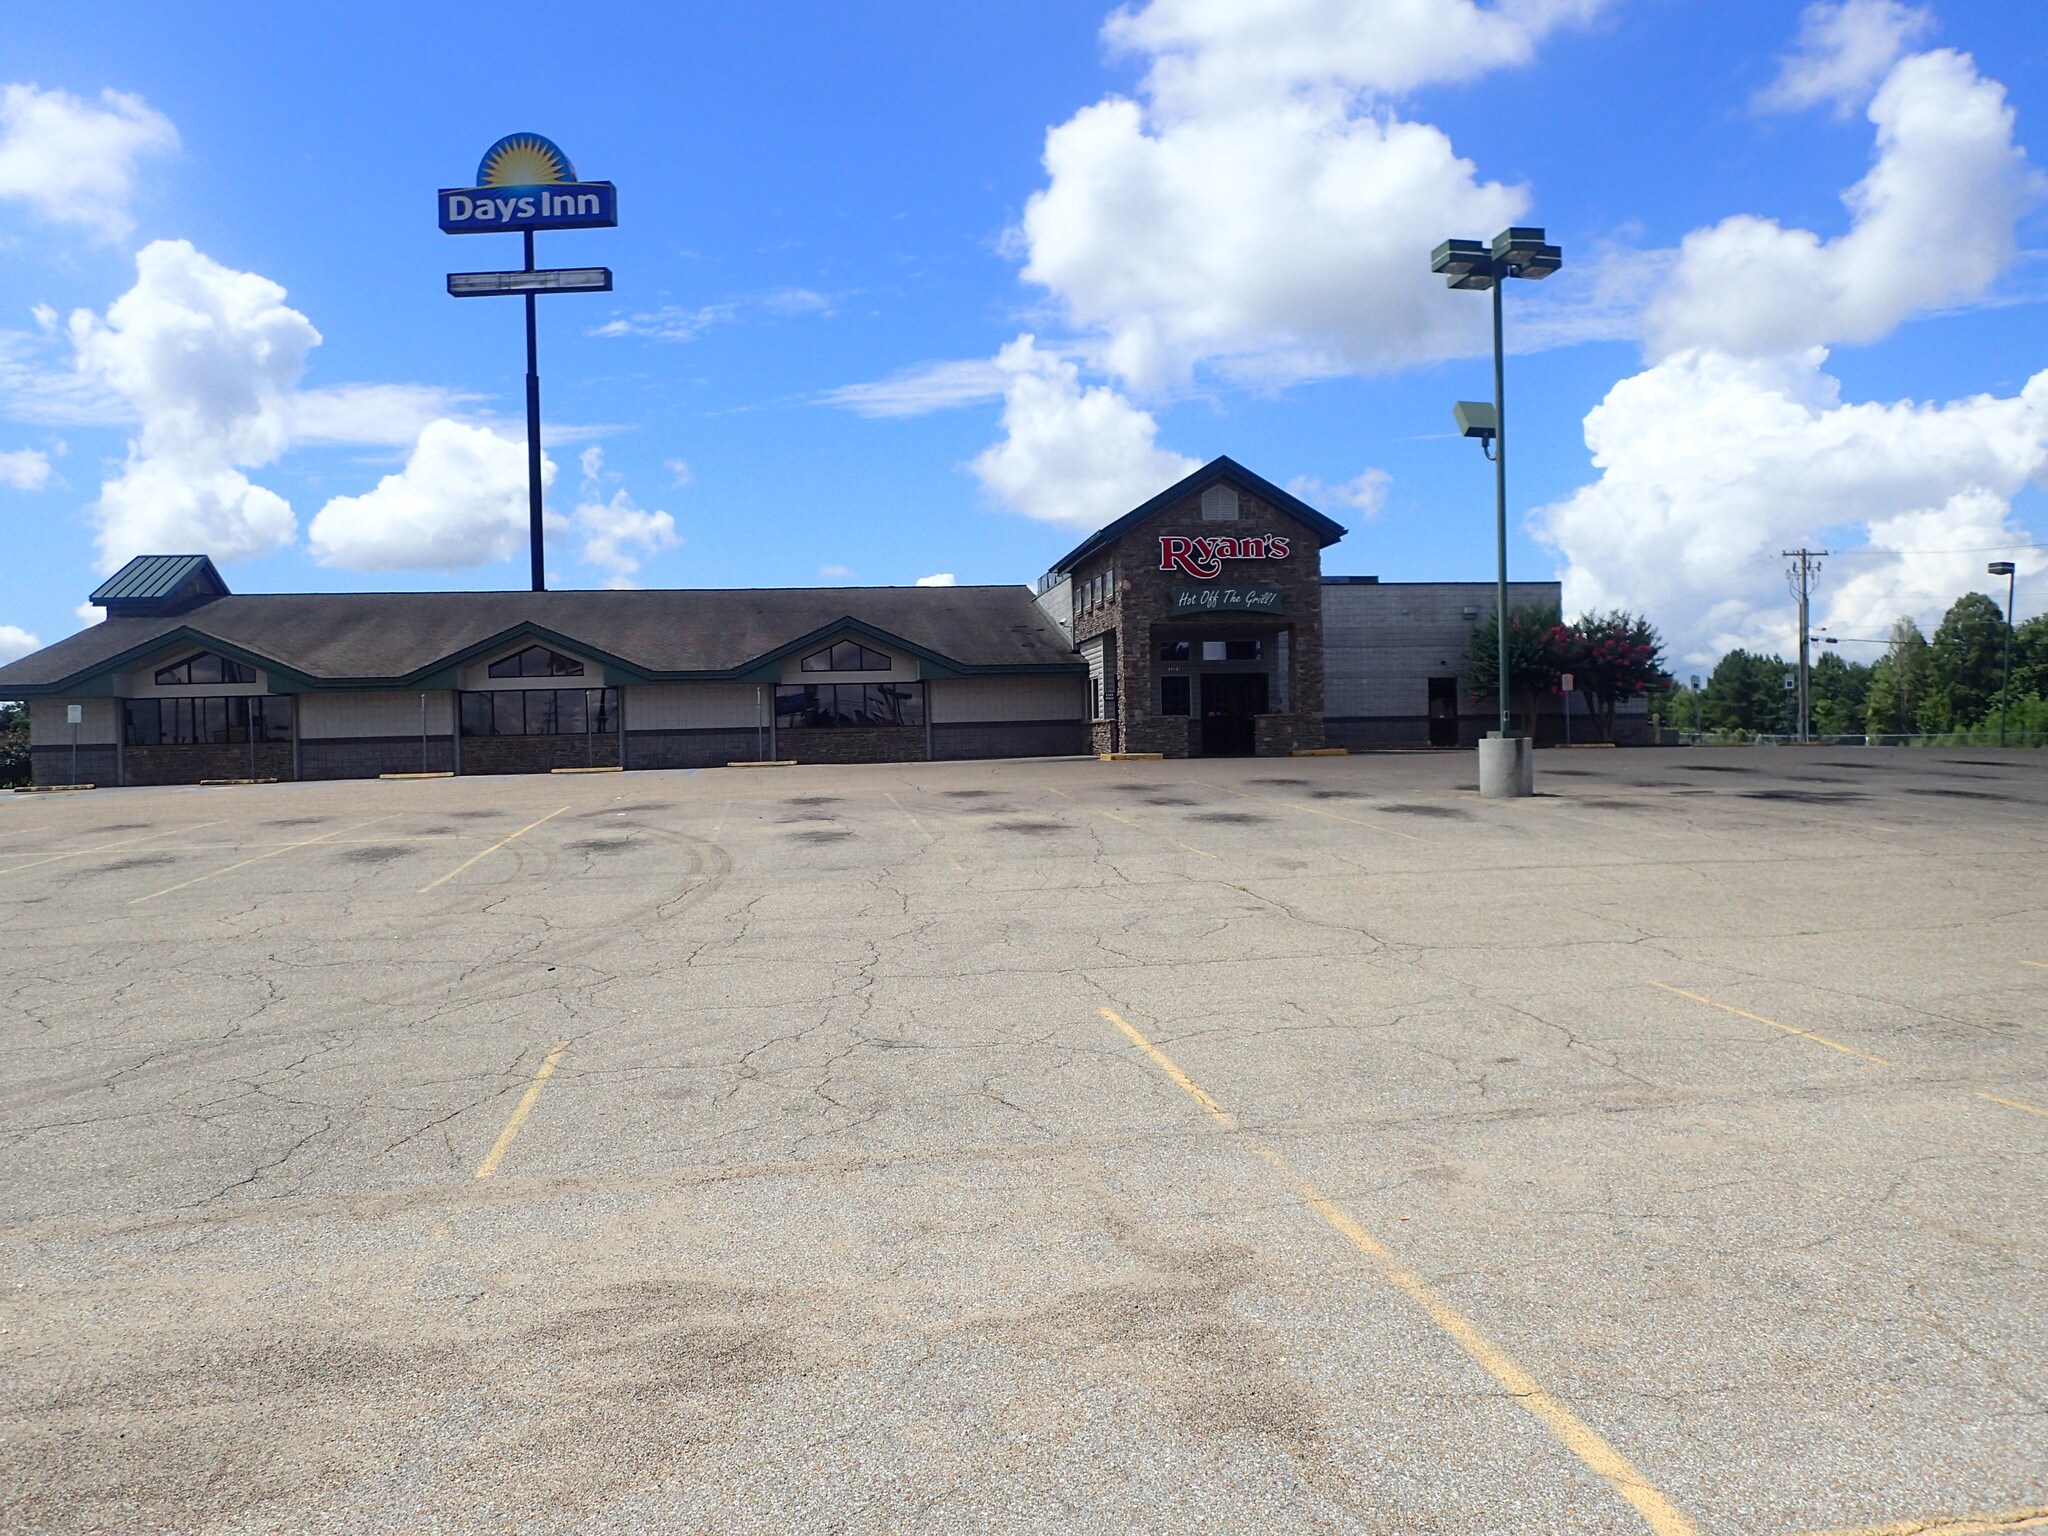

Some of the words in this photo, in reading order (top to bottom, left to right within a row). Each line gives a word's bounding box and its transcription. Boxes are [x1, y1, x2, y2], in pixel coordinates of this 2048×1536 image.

[449, 195, 536, 222] Days
[541, 191, 600, 217] Inn
[1159, 533, 1290, 579] Ryan's
[1179, 592, 1197, 606] Hot
[1200, 590, 1219, 608] Off
[1223, 590, 1241, 604] The
[1246, 591, 1277, 607] Grill!
